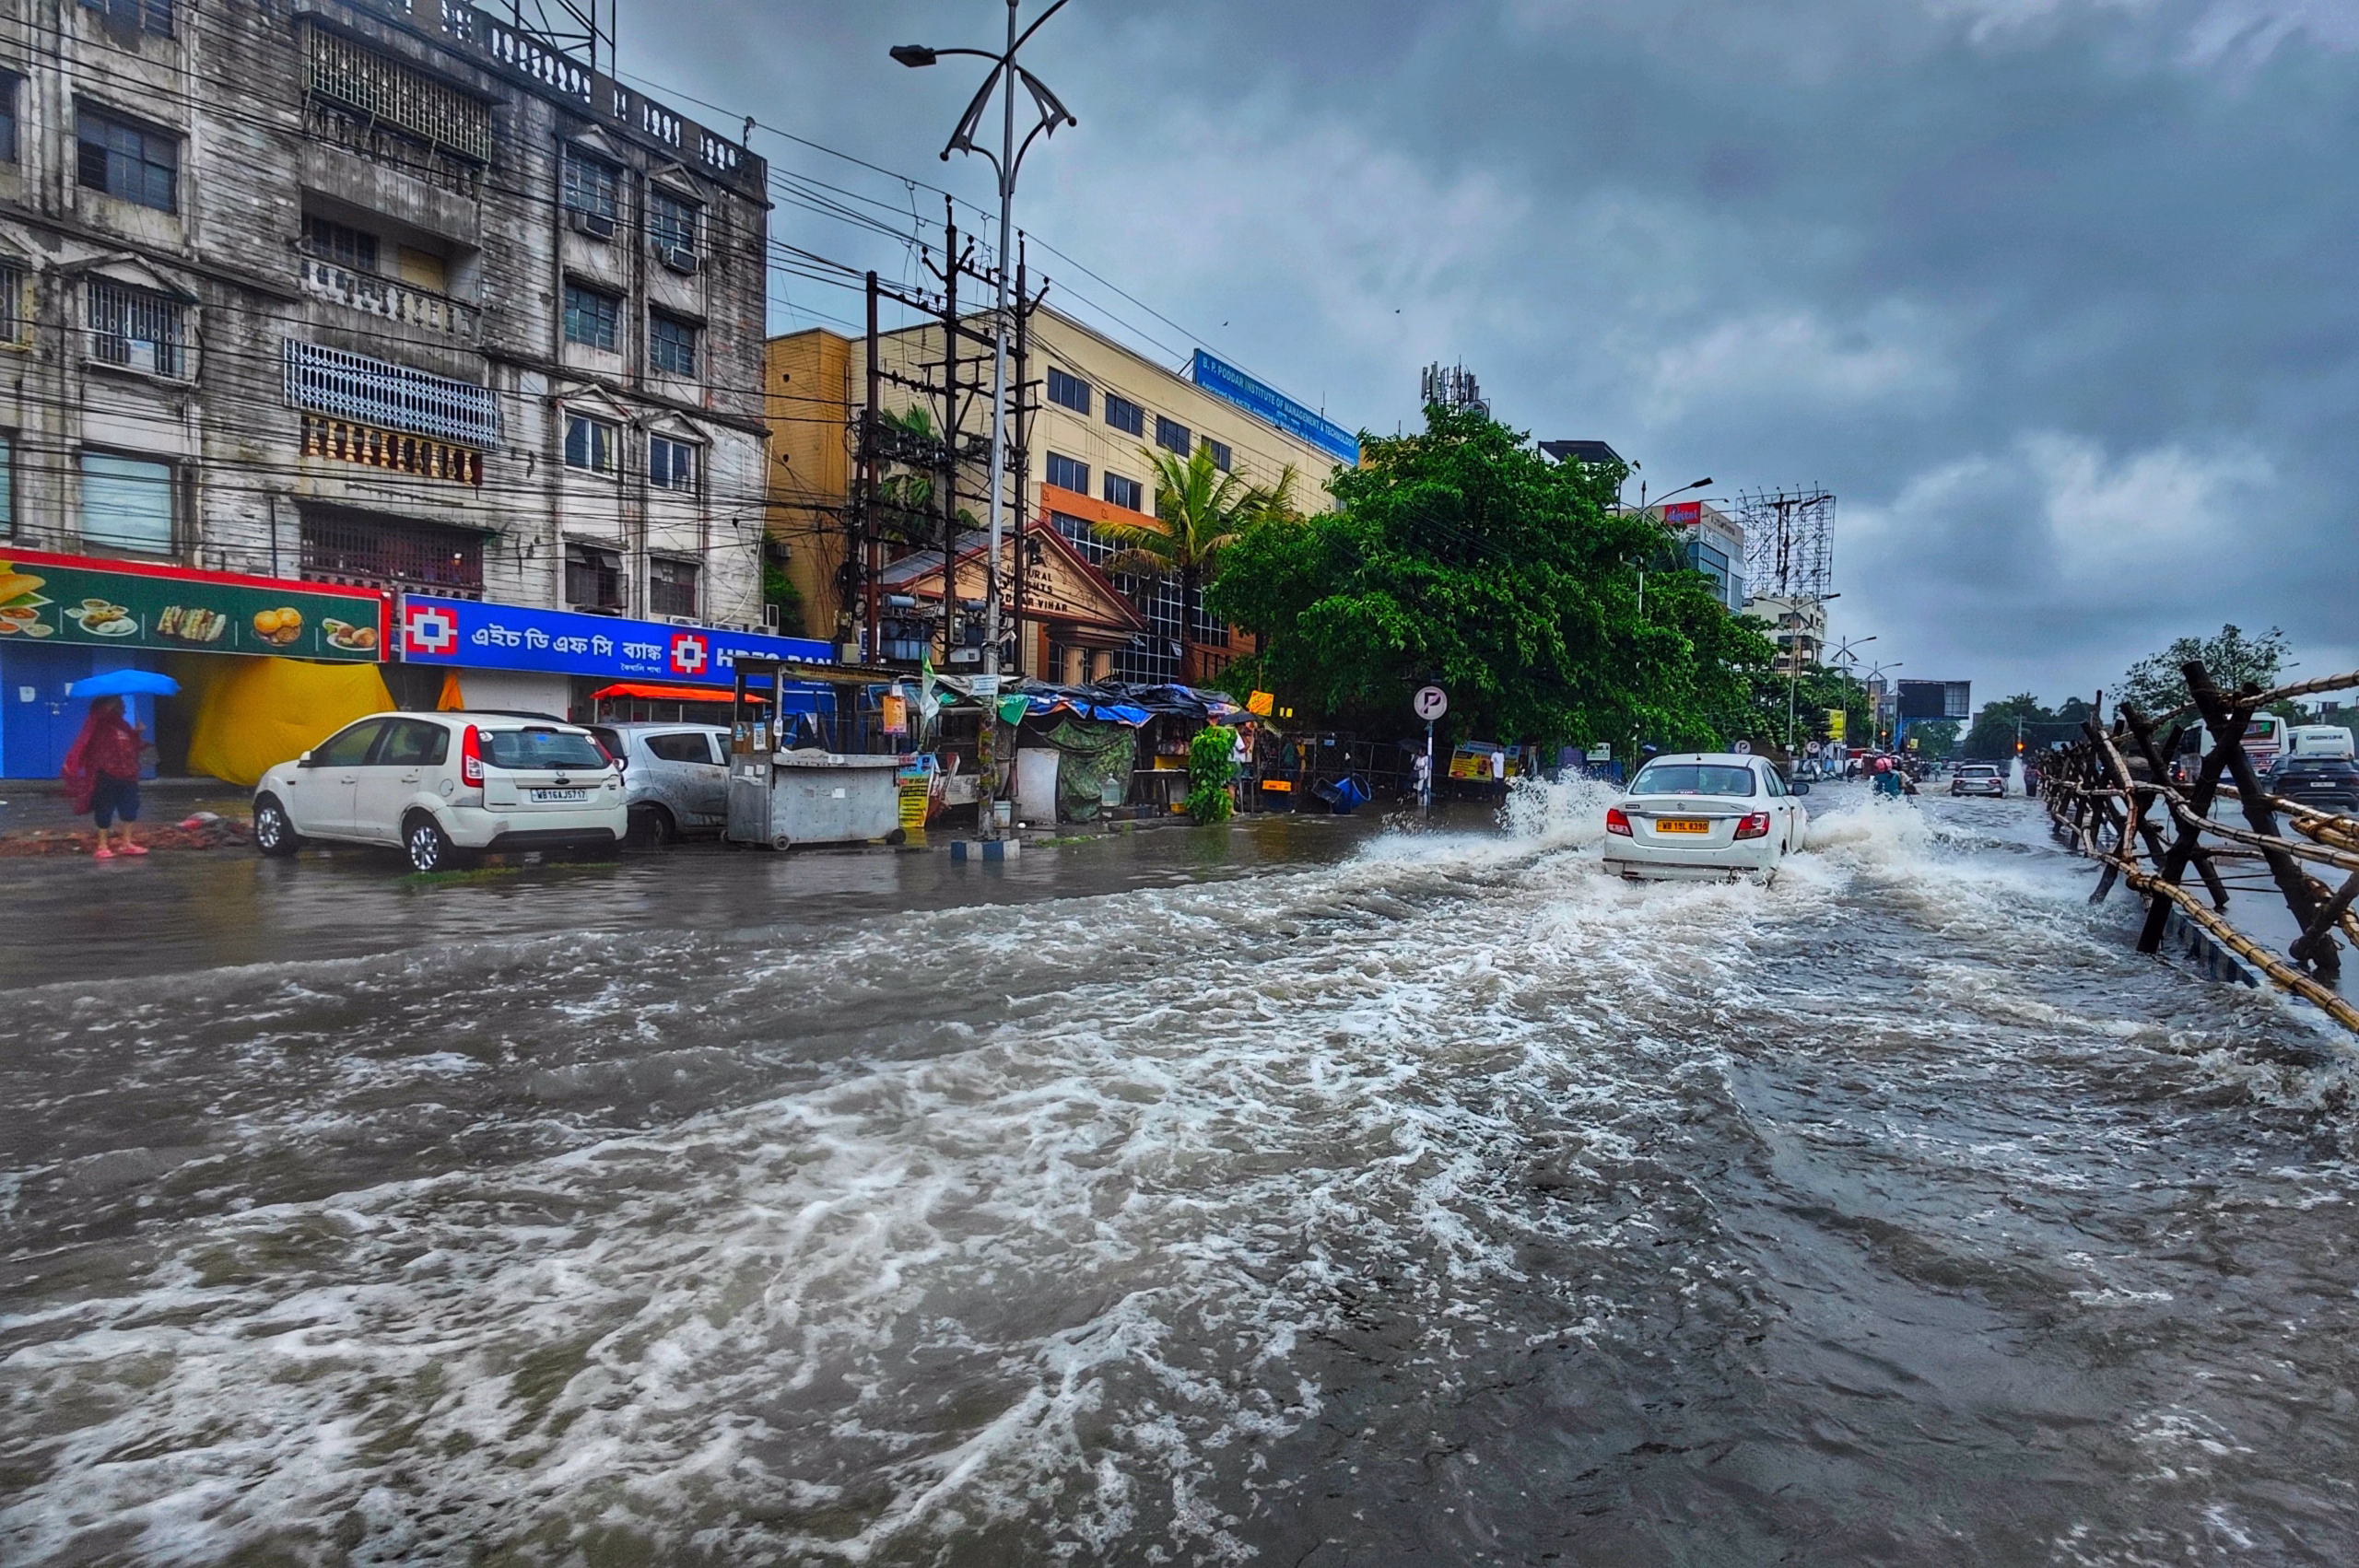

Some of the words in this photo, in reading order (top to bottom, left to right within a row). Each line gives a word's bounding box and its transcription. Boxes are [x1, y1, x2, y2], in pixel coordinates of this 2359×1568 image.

[1203, 357, 1210, 370] B.
[1211, 361, 1217, 373] P.
[1217, 365, 1244, 389] PODDAR
[1244, 380, 1275, 405] INSTITUTE
[1275, 397, 1284, 408] OF
[1284, 402, 1320, 429] MANAGEMENT
[1320, 422, 1324, 432] &
[1325, 424, 1356, 449] TECHNOLOGY
[1006, 564, 1053, 582] NTURAL
[1038, 599, 1068, 613] VIHAR
[471, 623, 522, 647] এইচ
[523, 626, 550, 649] ডি
[552, 636, 589, 654] এফ
[591, 634, 614, 657] সি
[1424, 692, 1441, 714] P
[1661, 822, 1672, 830] WB
